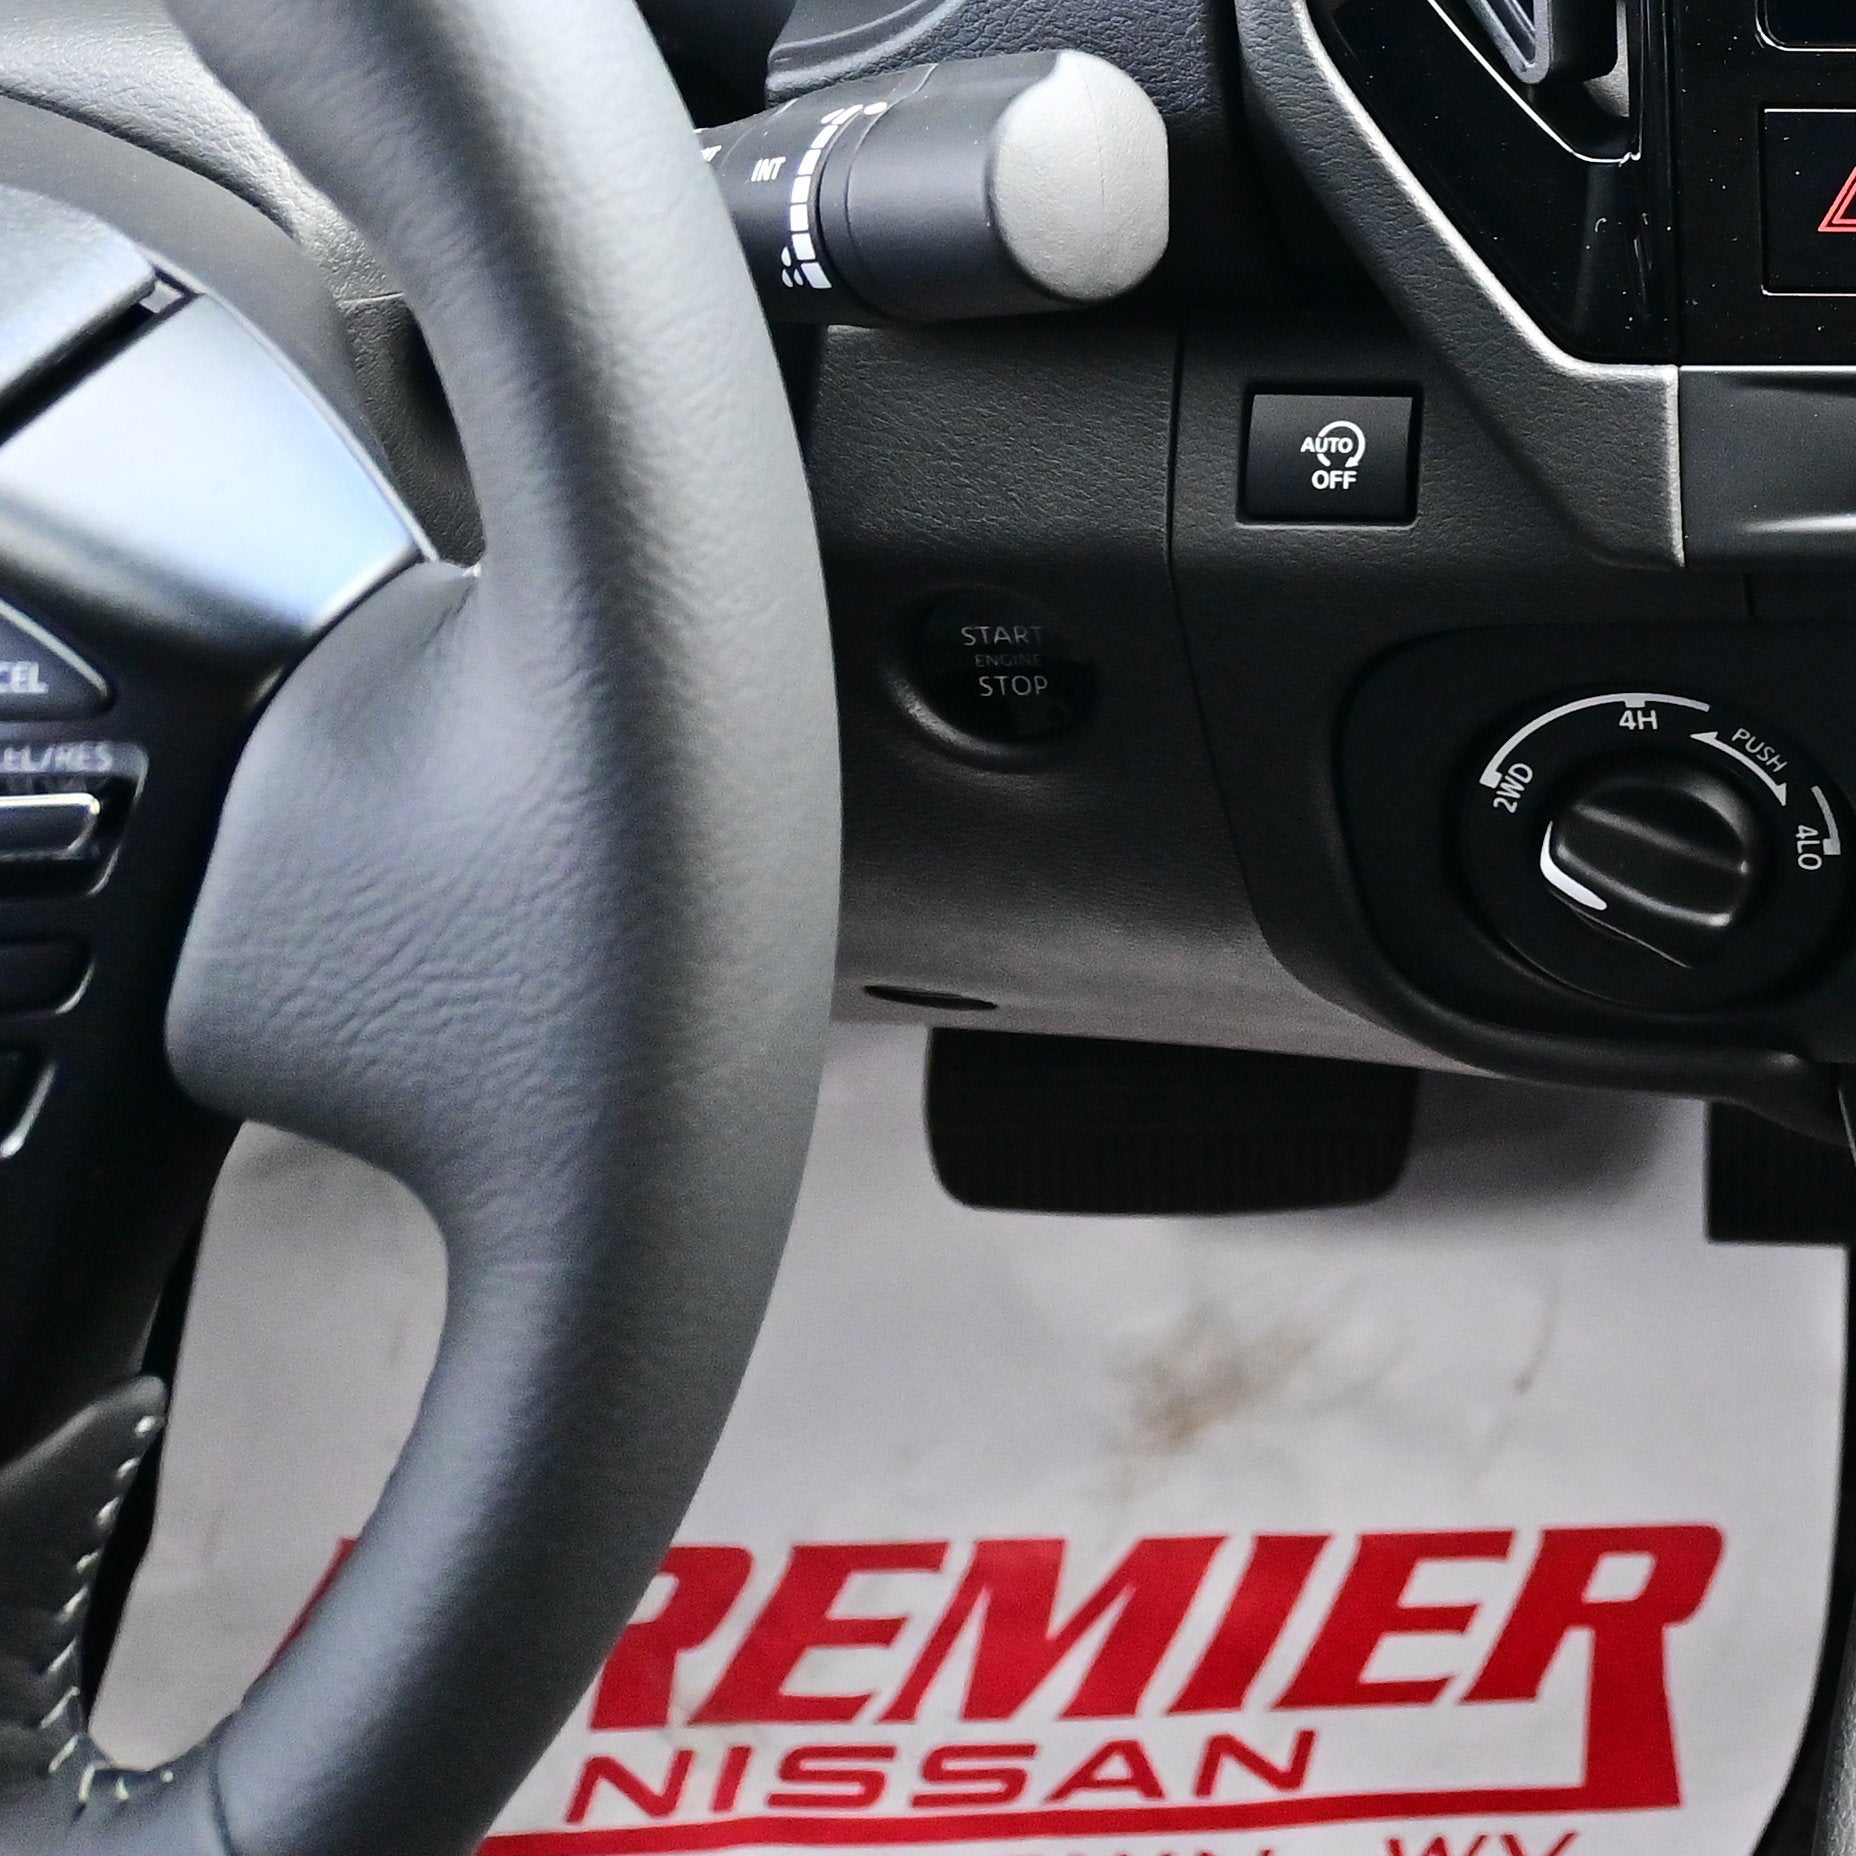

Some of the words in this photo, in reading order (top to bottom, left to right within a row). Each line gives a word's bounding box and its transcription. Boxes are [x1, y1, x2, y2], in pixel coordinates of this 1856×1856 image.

[751, 157, 786, 182] INT
[1300, 436, 1354, 454] AUTO
[1311, 469, 1357, 490] OFF
[960, 624, 1046, 647] START
[976, 674, 1050, 698] STOP
[1618, 709, 1658, 730] 4H
[1729, 728, 1787, 777] PUSH
[1492, 761, 1536, 816] 2WD
[1794, 823, 1823, 872] 4LO
[262, 1525, 1723, 1731] REMIER
[564, 1729, 1318, 1827] NISSAN
